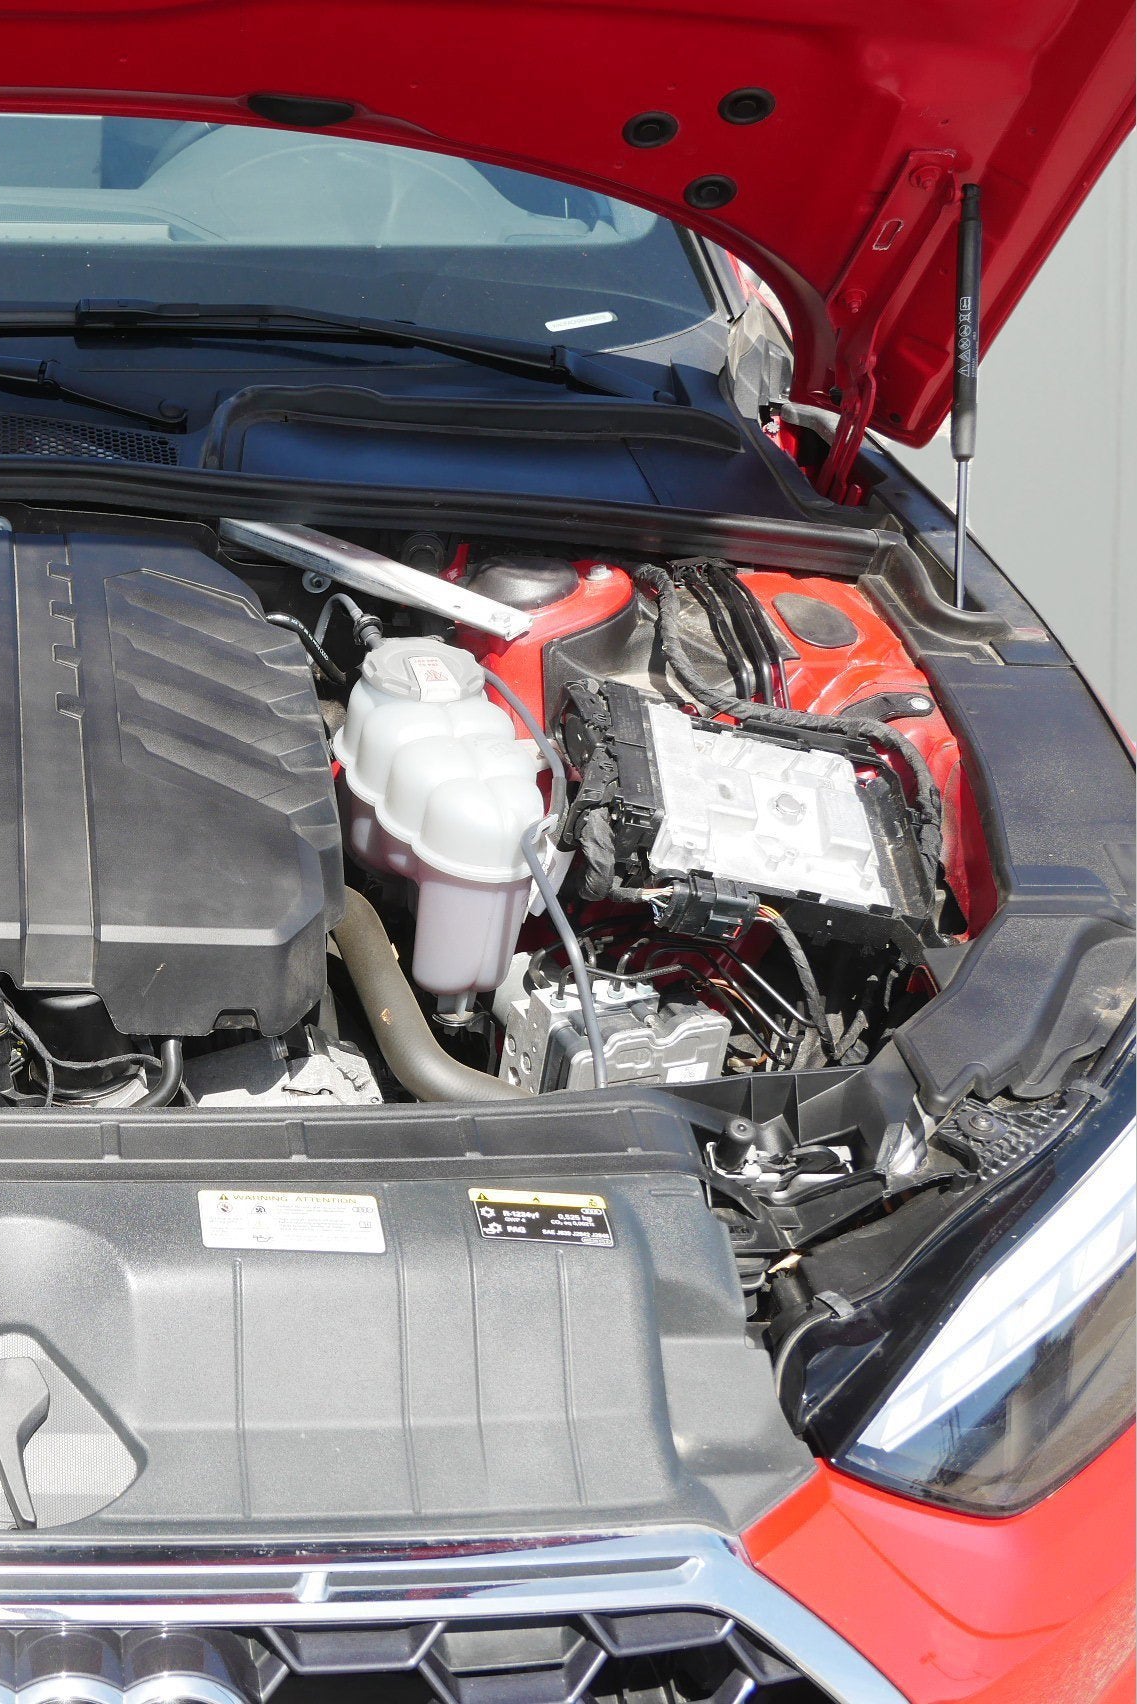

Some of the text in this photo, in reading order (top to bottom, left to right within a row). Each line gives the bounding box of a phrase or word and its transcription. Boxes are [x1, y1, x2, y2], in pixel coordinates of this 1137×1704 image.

[233, 1194, 357, 1204] WARNING ATTENTION
[581, 1214, 593, 1223] kg
